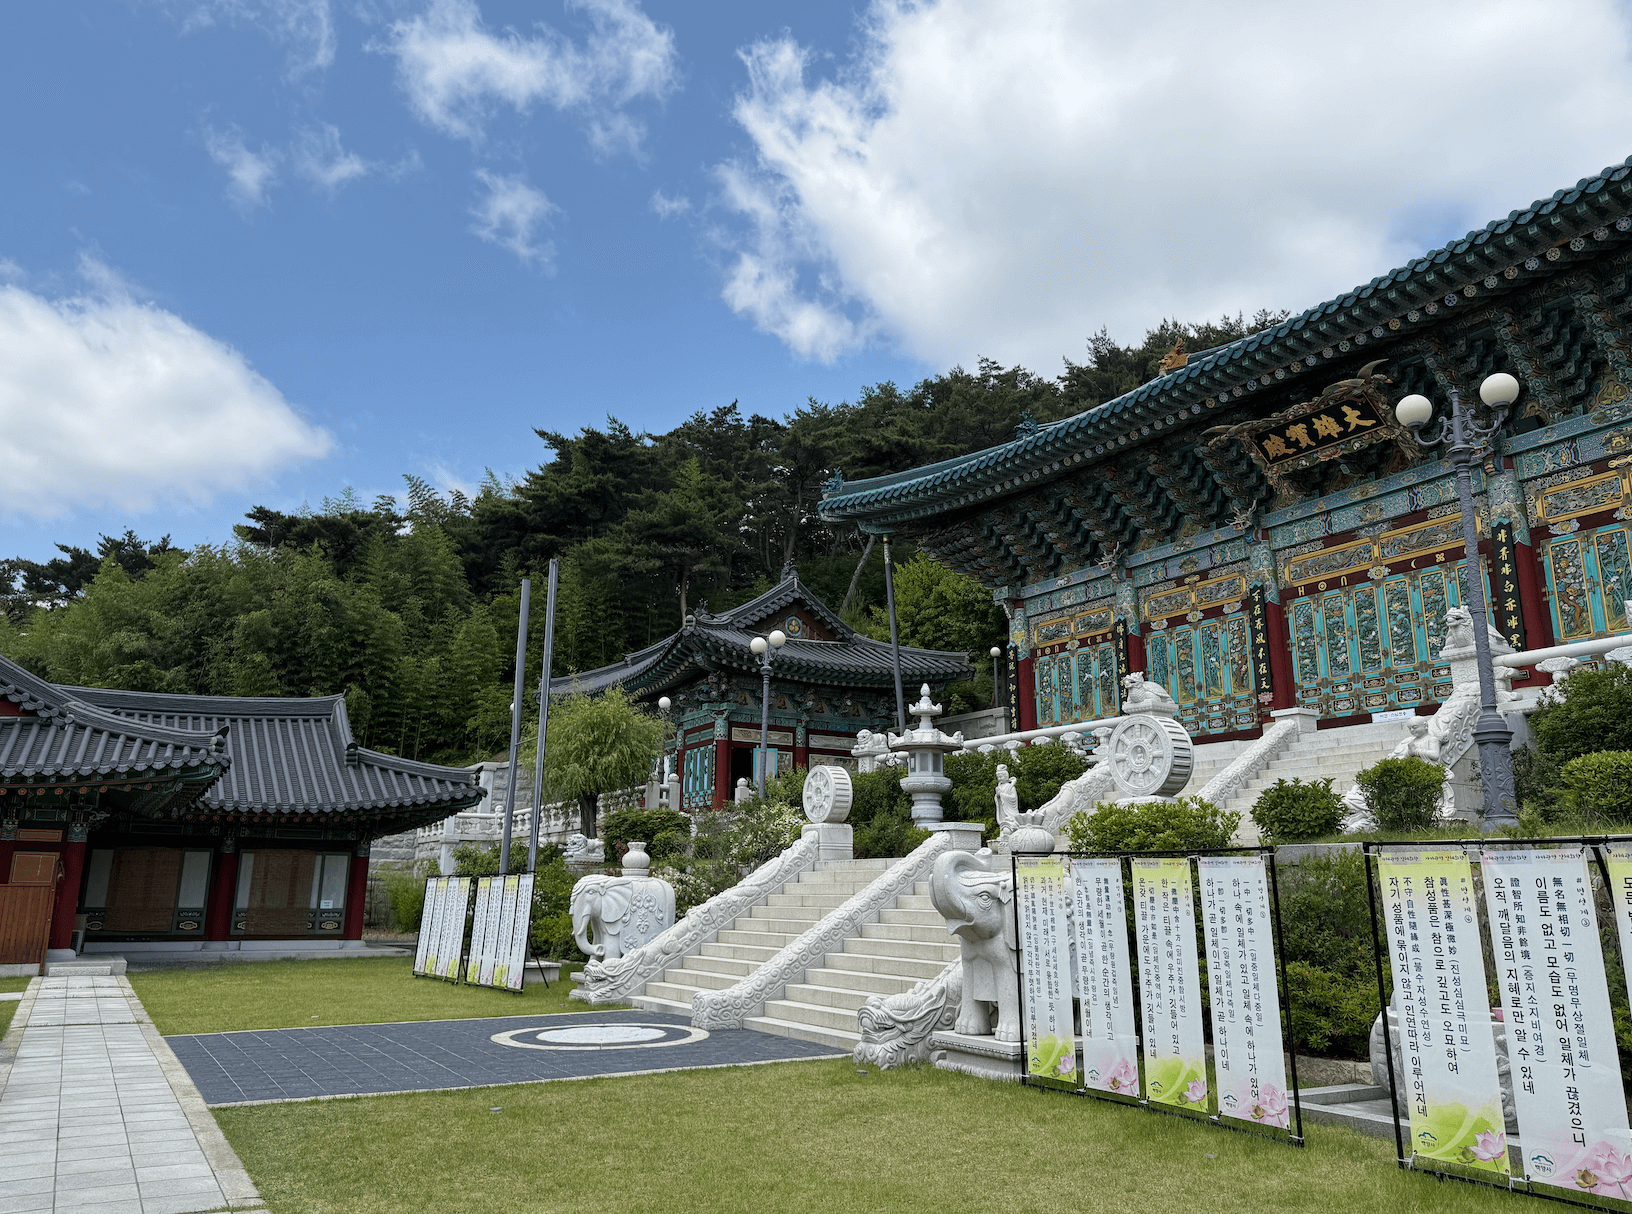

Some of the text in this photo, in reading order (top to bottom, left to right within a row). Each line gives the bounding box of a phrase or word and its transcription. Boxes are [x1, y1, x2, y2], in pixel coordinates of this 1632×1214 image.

[1040, 876, 1046, 894] 과거
[1075, 877, 1082, 887] 한
[1095, 877, 1103, 907] 무량한
[1076, 889, 1084, 918] 순간의
[1097, 909, 1106, 939] 세월이
[1079, 921, 1087, 950] 생각이
[1431, 932, 1446, 970] 참으로
[1082, 965, 1090, 996] 무량한
[1102, 967, 1110, 998] 순간의
[1139, 877, 1157, 1059] 온갖 티끌 가운데도 우주가 깃들어 있네
[1161, 878, 1180, 1055] 한 작은 티끌 속에 우주가 깃들어 있고
[1206, 877, 1230, 1071] 하나가 곧 일체이고 일체가 곧 하나이네
[1494, 877, 1534, 1095] 오직 깨달음의 지혜로만 알 수 있네
[1552, 877, 1574, 963] 無名無相切一切
[1564, 967, 1591, 1068] (무명무상절일체)
[1232, 877, 1260, 1101] 하나 속에 일체가 있고 일체 속에 하나가 있어
[1389, 876, 1428, 1117] 자기 성품에 묶이지 않고 인연따라 이루어지네
[1436, 976, 1452, 1015] 깊고도
[1104, 1000, 1114, 1041] 생각이고
[1521, 964, 1547, 1063] (증지소지비여경)
[1535, 876, 1586, 1147] 이름도 없고 모습도 없어 일체가 끊겼으니
[1442, 1020, 1458, 1074] 오묘하여
